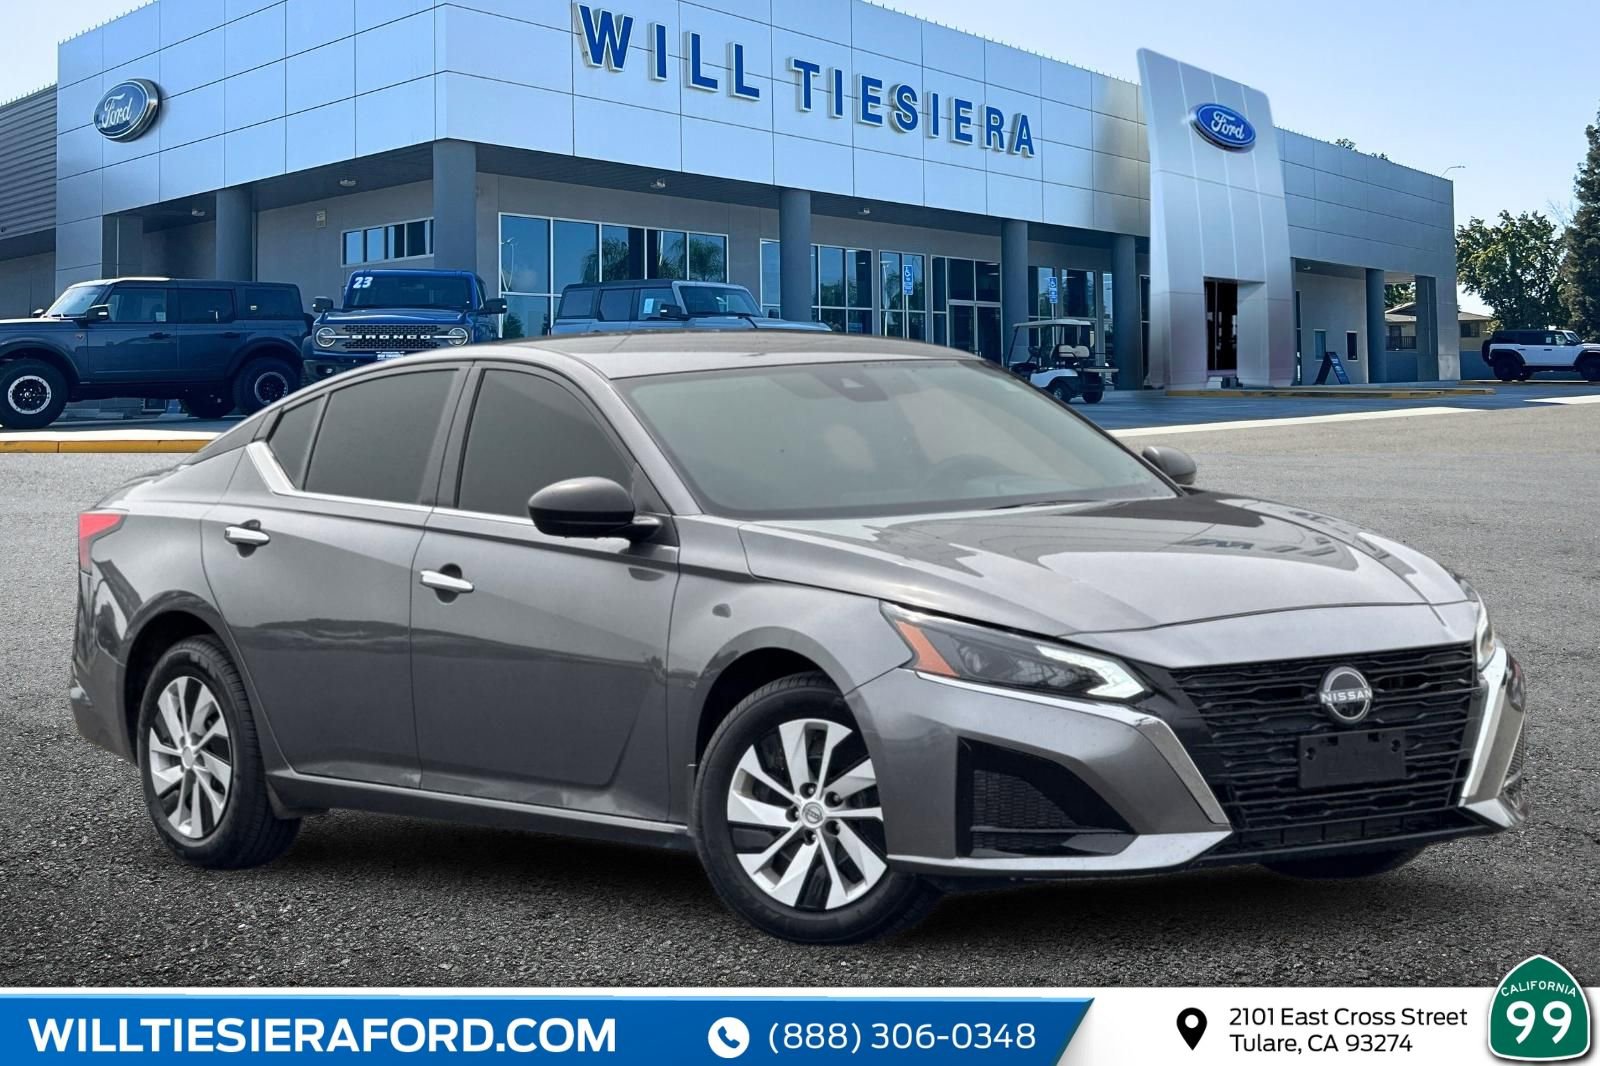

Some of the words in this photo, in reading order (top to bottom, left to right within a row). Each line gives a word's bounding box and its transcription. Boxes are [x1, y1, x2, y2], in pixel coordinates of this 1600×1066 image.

[573, 2, 760, 101] WILL
[788, 56, 1036, 158] TIESIERA
[101, 92, 134, 129] Ford
[1210, 110, 1246, 140] Ford
[352, 276, 374, 290] 23
[1320, 688, 1373, 704] NISSAN
